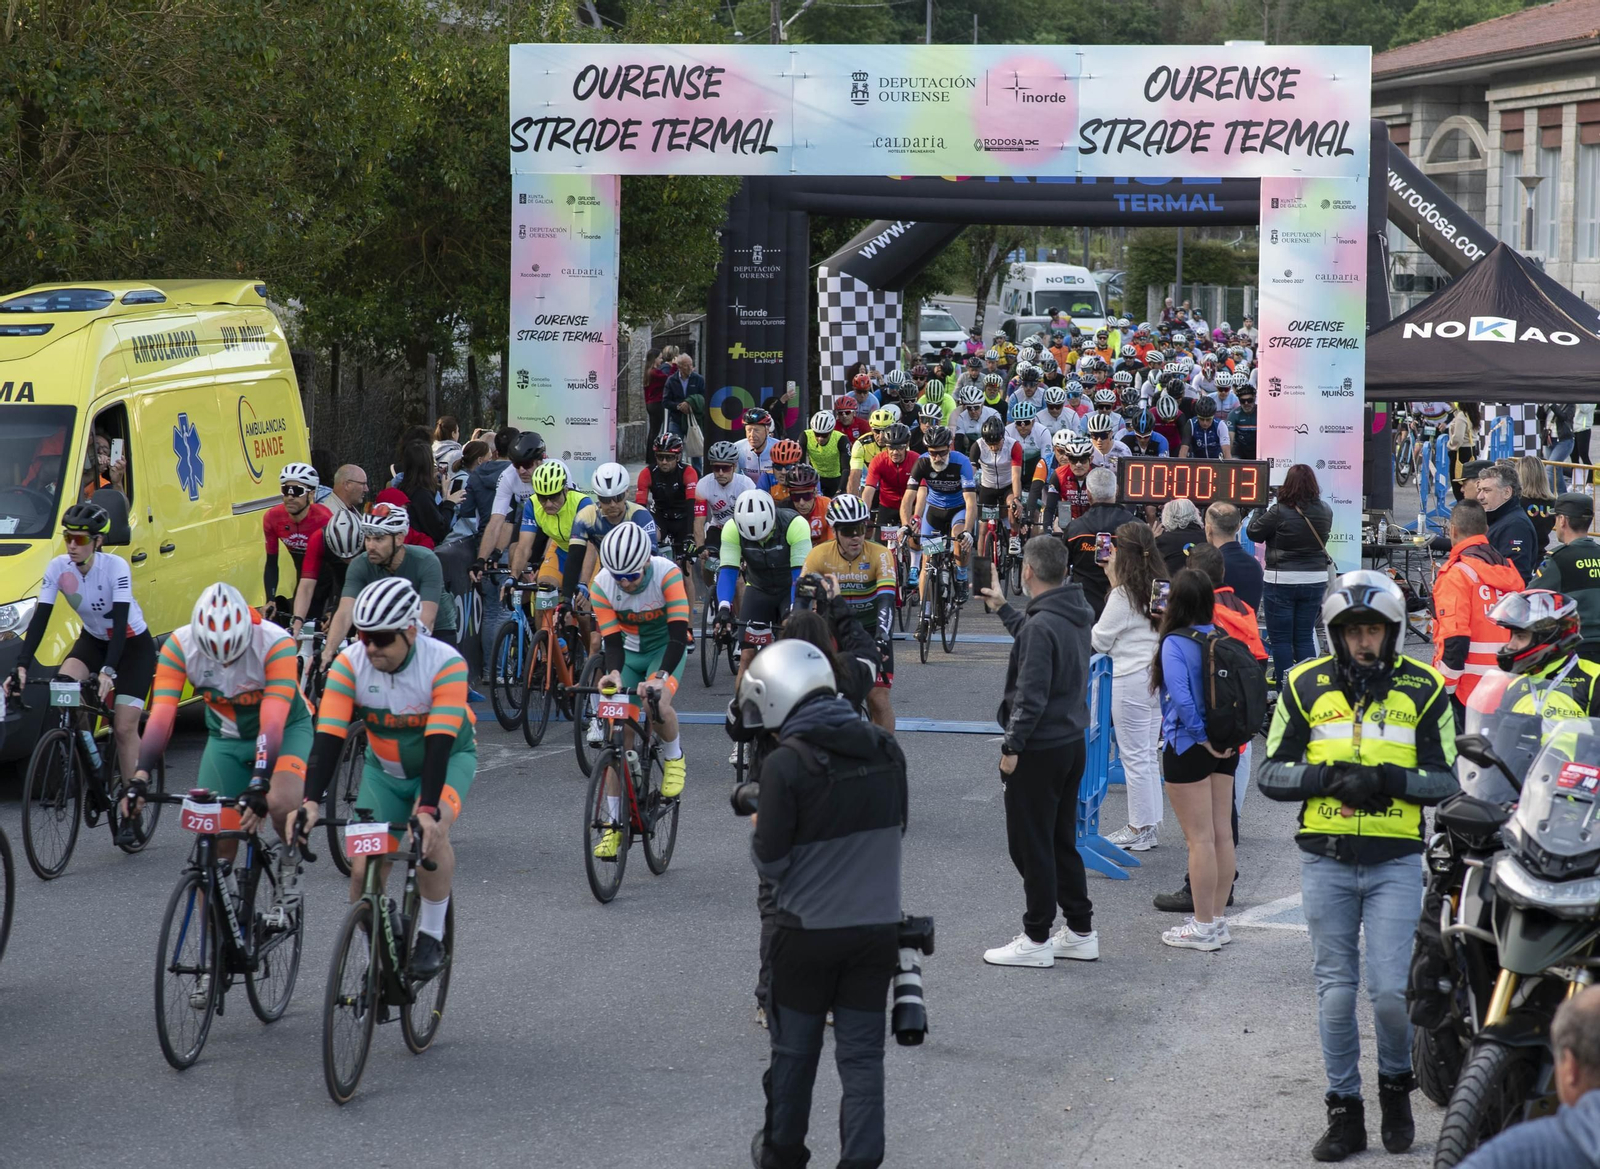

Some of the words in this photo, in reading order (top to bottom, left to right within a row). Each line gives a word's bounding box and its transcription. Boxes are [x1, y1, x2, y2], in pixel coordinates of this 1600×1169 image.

[573, 64, 726, 102] OURENSE
[878, 74, 977, 89] DEPUTACIÓN
[1144, 65, 1301, 103] OURENSE
[878, 91, 951, 103] OURENSE
[1022, 92, 1067, 104] inorde
[510, 116, 643, 155] STRADE
[650, 117, 779, 155] TERMAL
[984, 138, 1024, 146] RODOSA
[1078, 118, 1216, 157] STRADE
[1223, 118, 1355, 158] TERMAL
[1113, 193, 1224, 213] TERMAL
[534, 314, 589, 326] OURENSE
[1288, 321, 1345, 332] OURENSE
[517, 330, 560, 342] STRADE
[562, 331, 604, 343] TERMAL
[1269, 336, 1313, 349] STRADE
[1316, 337, 1359, 349] TERMAL
[131, 330, 200, 364] AMBULANCIA
[245, 418, 287, 437] AMBULANCIAS
[254, 436, 285, 458] BANDE
[1127, 464, 1258, 501] 00:00:13
[541, 600, 553, 608] 94
[749, 635, 767, 643] 275
[57, 694, 71, 704] 40
[602, 706, 624, 716] 284
[187, 816, 213, 831] 276
[353, 837, 381, 853] 283
[379, 895, 400, 972] ORBEA
